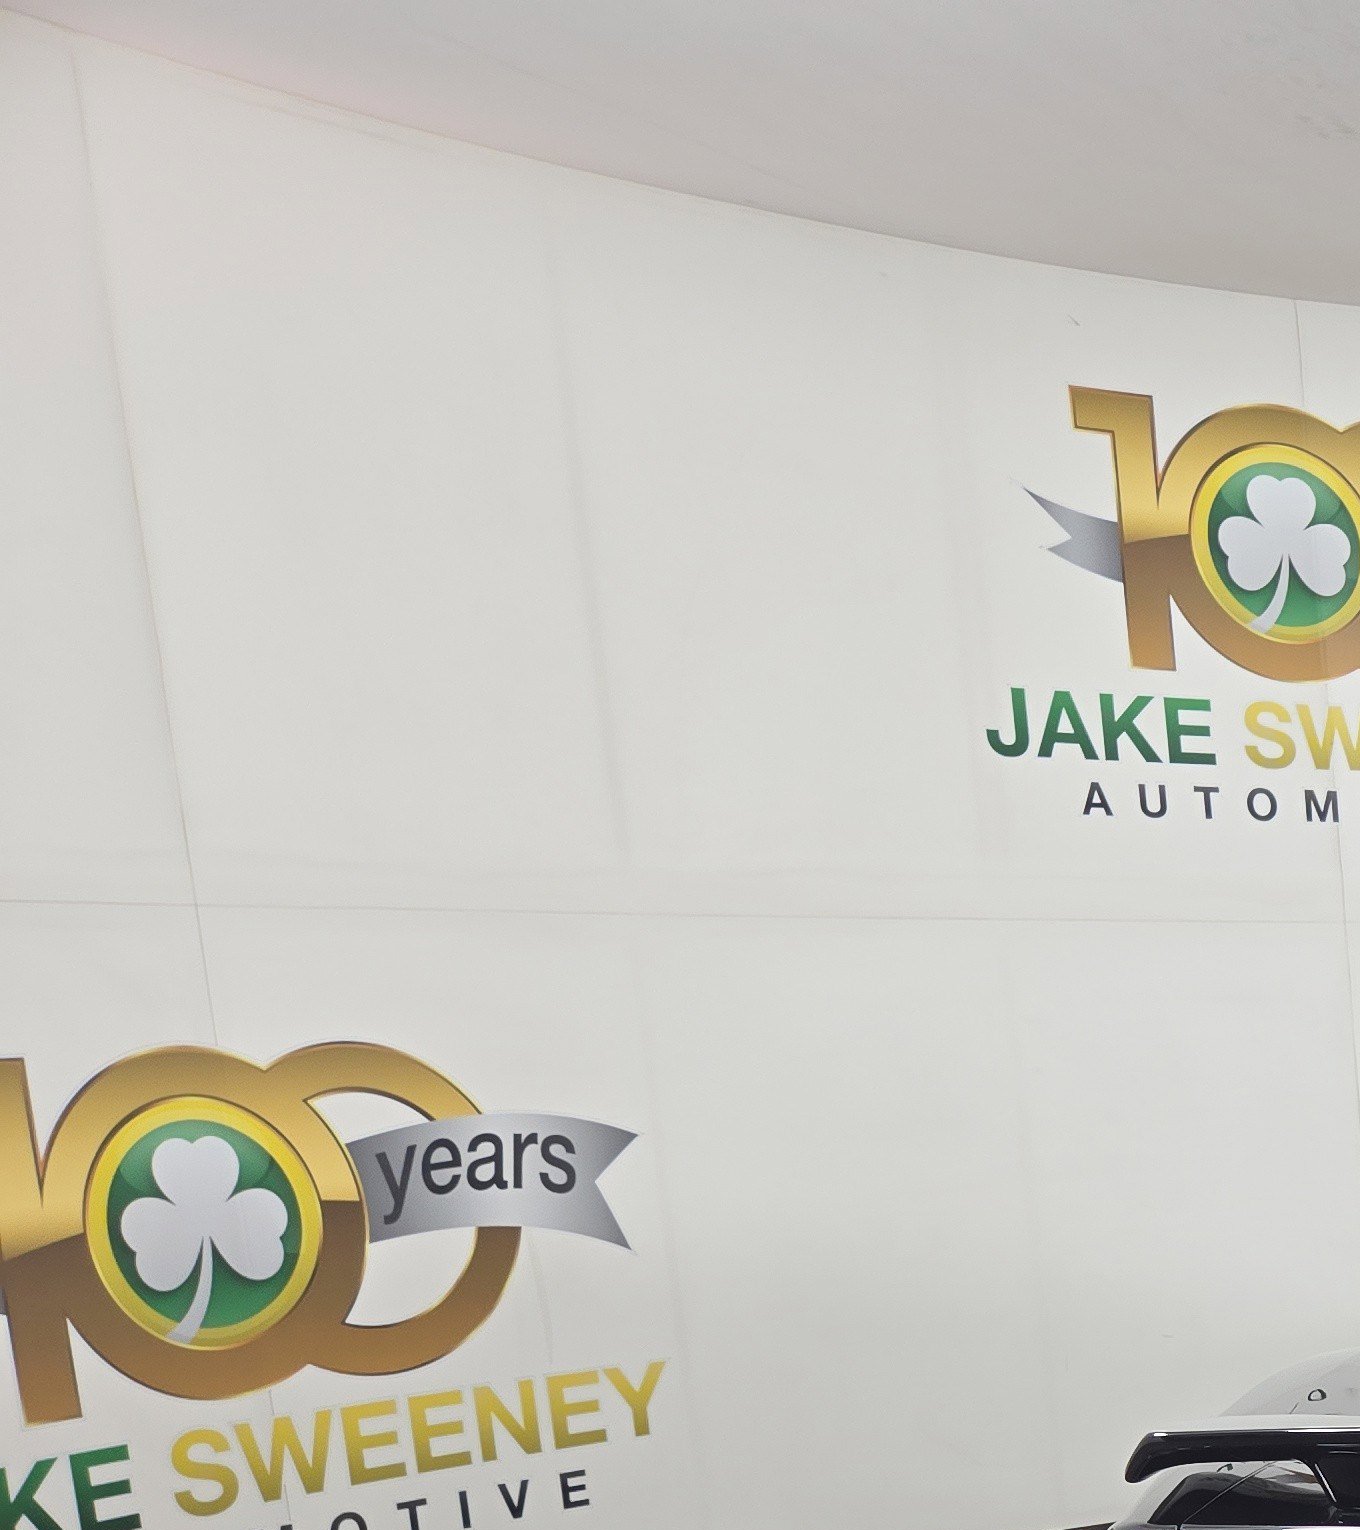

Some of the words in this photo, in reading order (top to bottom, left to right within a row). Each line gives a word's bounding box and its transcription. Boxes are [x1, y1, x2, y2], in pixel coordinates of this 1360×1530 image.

[985, 685, 1218, 766] JAKE
[375, 1131, 577, 1226] years
[170, 1360, 667, 1517] SWEENEY
